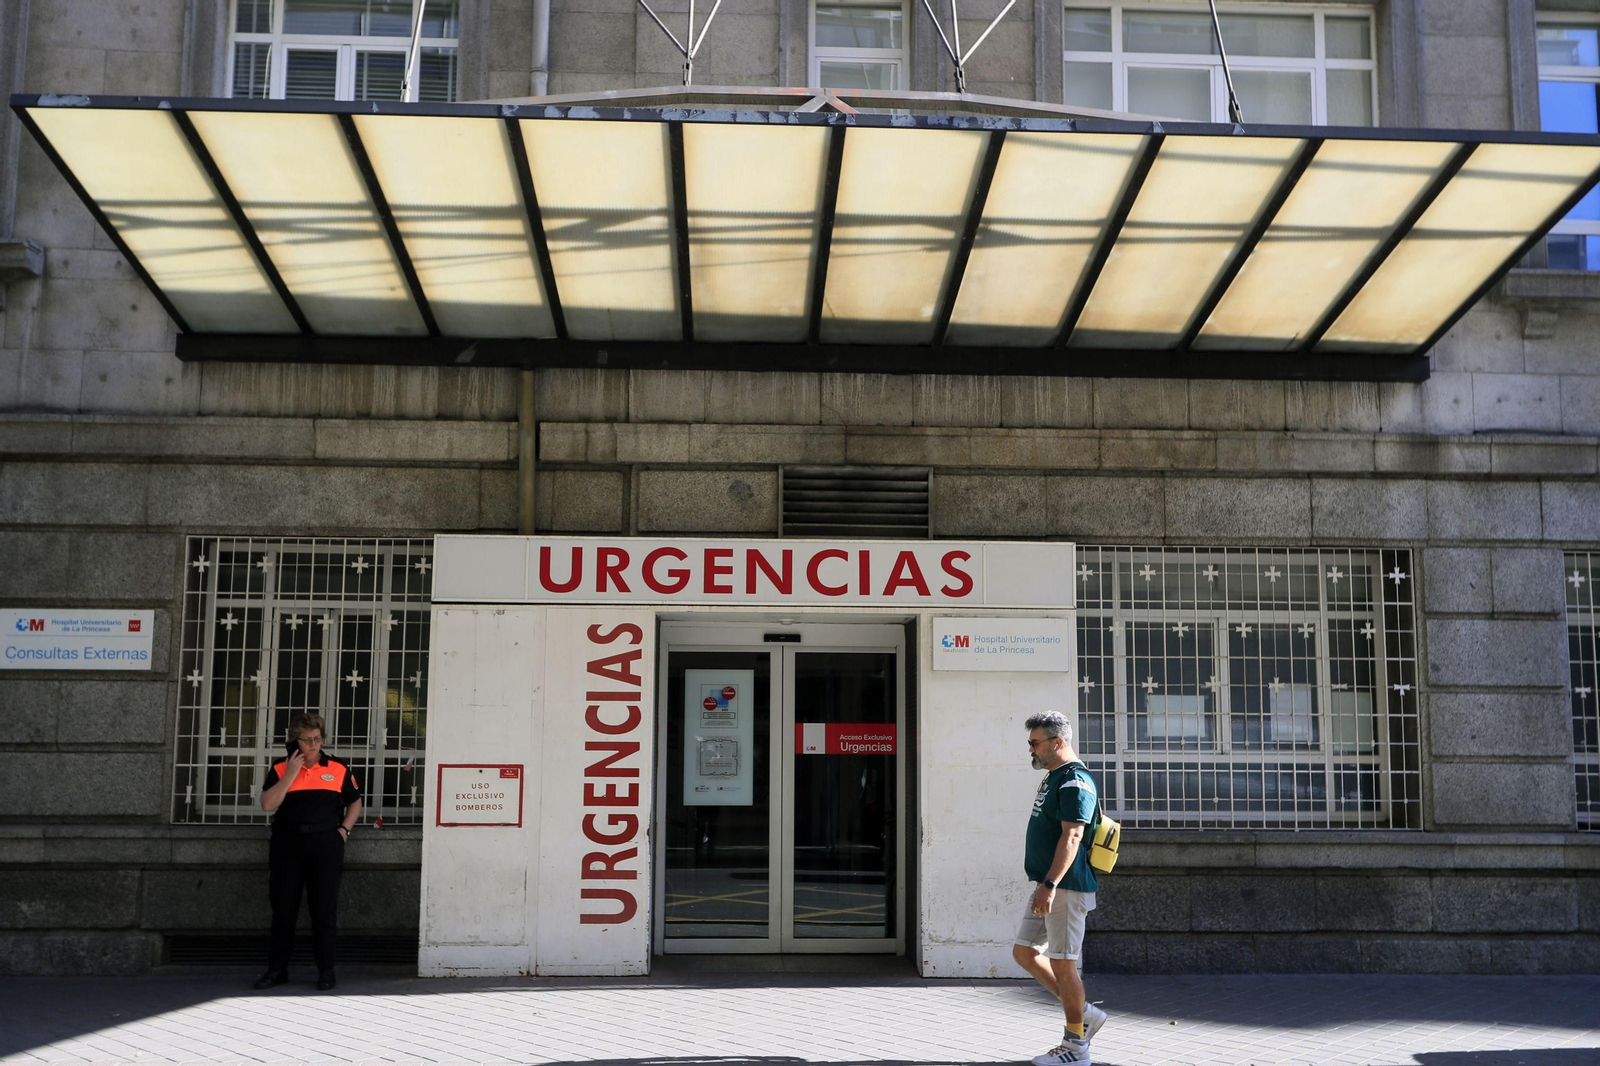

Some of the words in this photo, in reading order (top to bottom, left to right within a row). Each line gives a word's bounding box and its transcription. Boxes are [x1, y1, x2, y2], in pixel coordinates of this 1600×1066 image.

[539, 546, 974, 598] URGENCIAS
[29, 619, 45, 631] M
[955, 635, 969, 648] M
[974, 635, 1008, 644] Hospital
[1010, 636, 1061, 644] Universitario
[5, 646, 79, 660] Consultas
[84, 647, 148, 661] Externas
[974, 646, 985, 654] de
[987, 646, 997, 654] La
[840, 742, 893, 754] Urgencias
[580, 622, 643, 924] URGENCIAS
[455, 792, 505, 800] EXCLUSIVO
